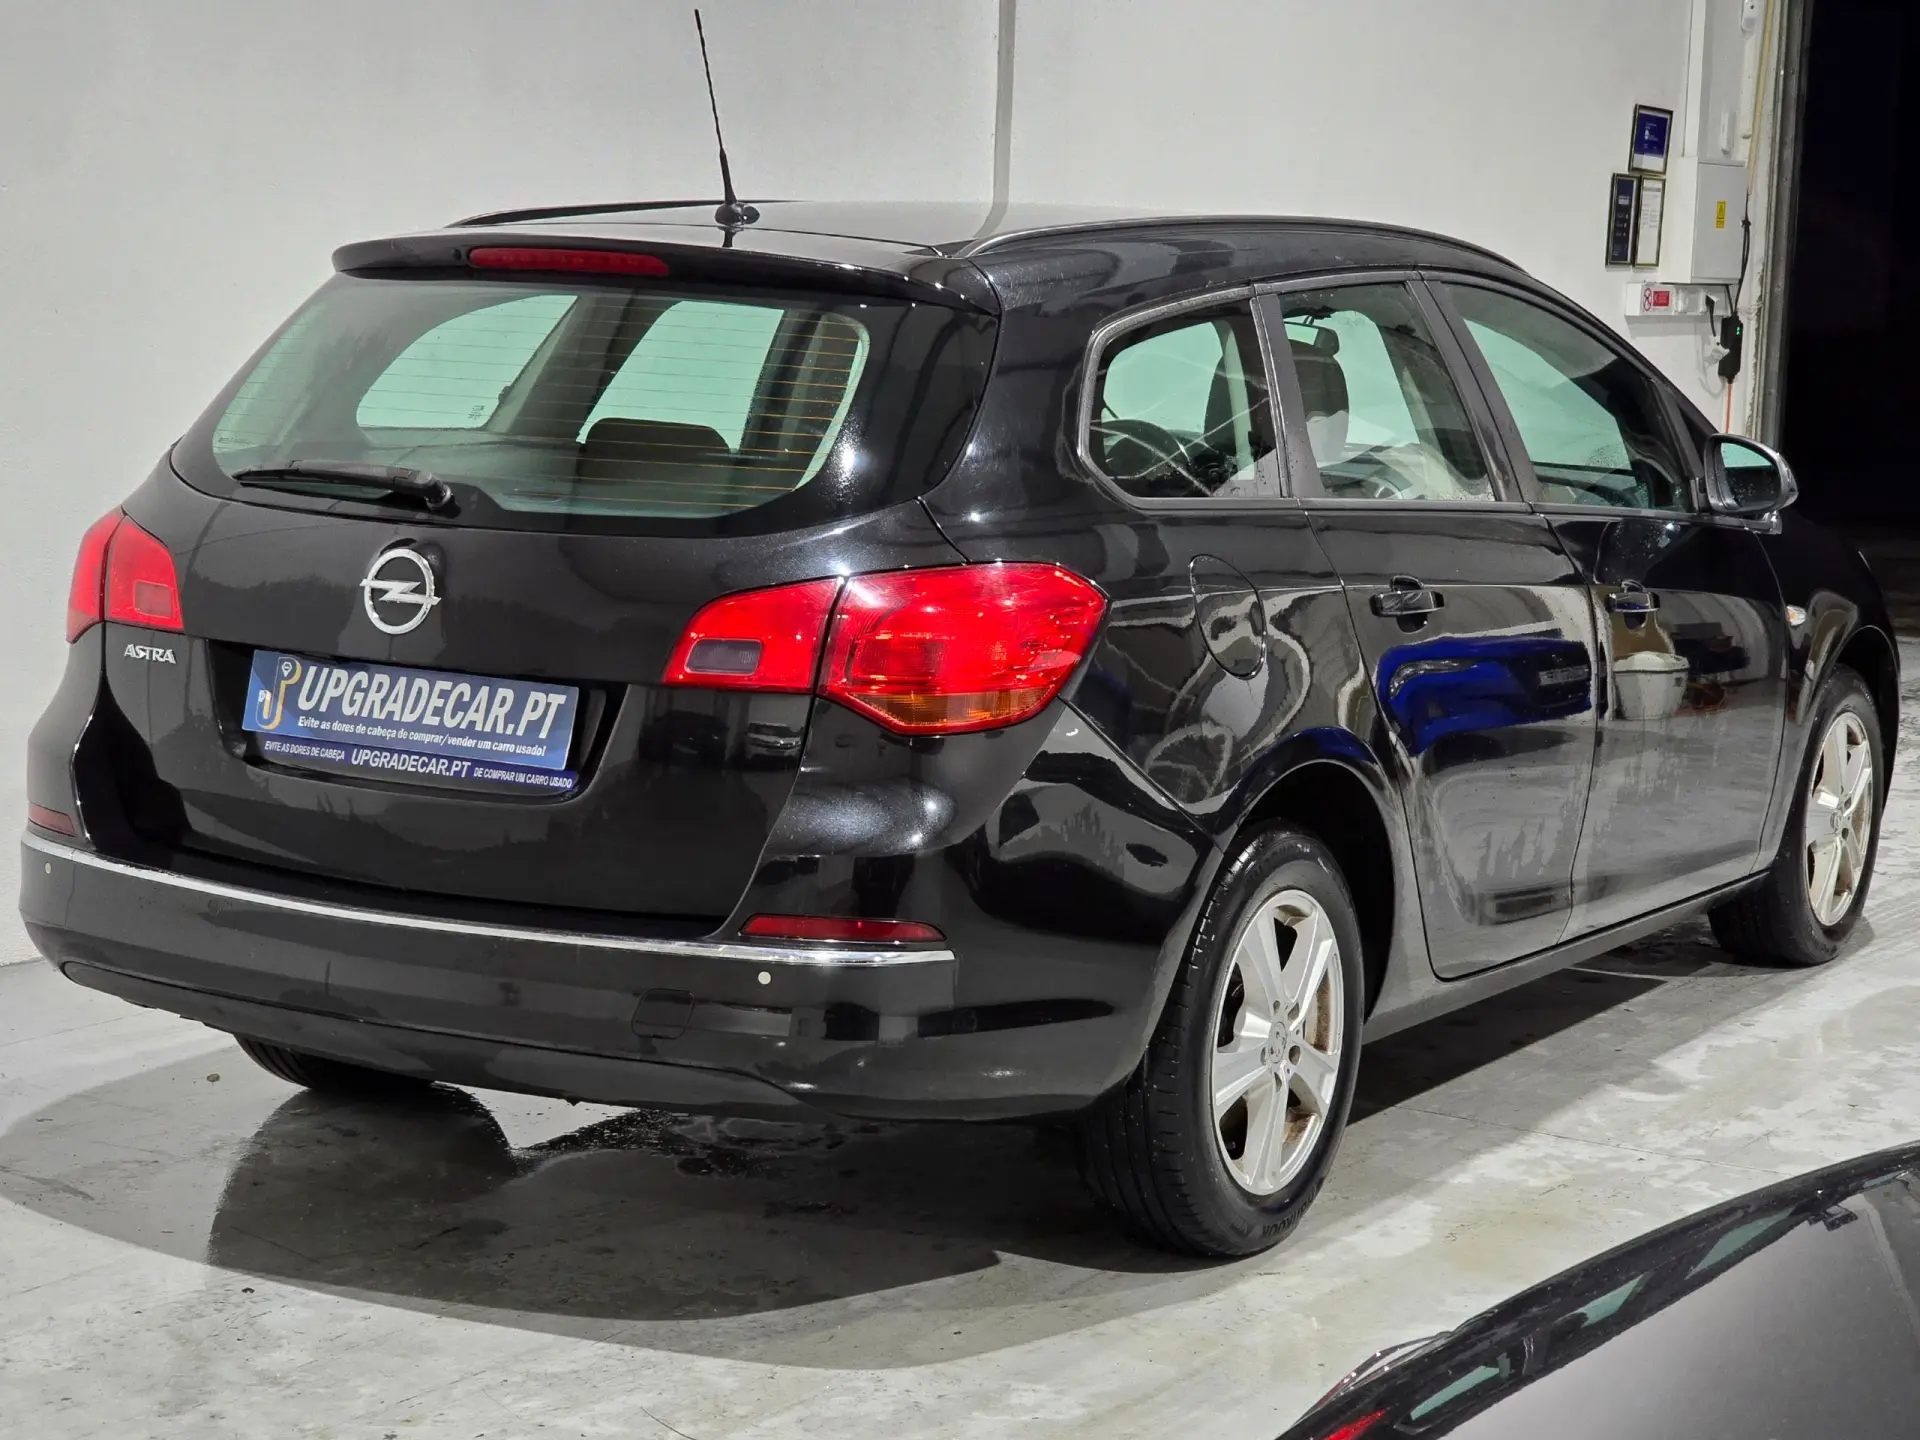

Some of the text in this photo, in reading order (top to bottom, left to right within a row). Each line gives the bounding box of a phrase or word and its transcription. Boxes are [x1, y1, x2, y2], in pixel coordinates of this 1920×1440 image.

[124, 644, 176, 664] ASTRA
[297, 665, 567, 739] UPGRADECAR.PT
[298, 716, 546, 757] Evite as dores de cabeça de comprar/vender um carro usado!
[264, 740, 345, 761] EVITE AS DORES DE CABEÇA
[351, 748, 471, 778] UPGRADECAR.PT
[473, 767, 573, 789] DE COMPRAR UM CARRO USADO
